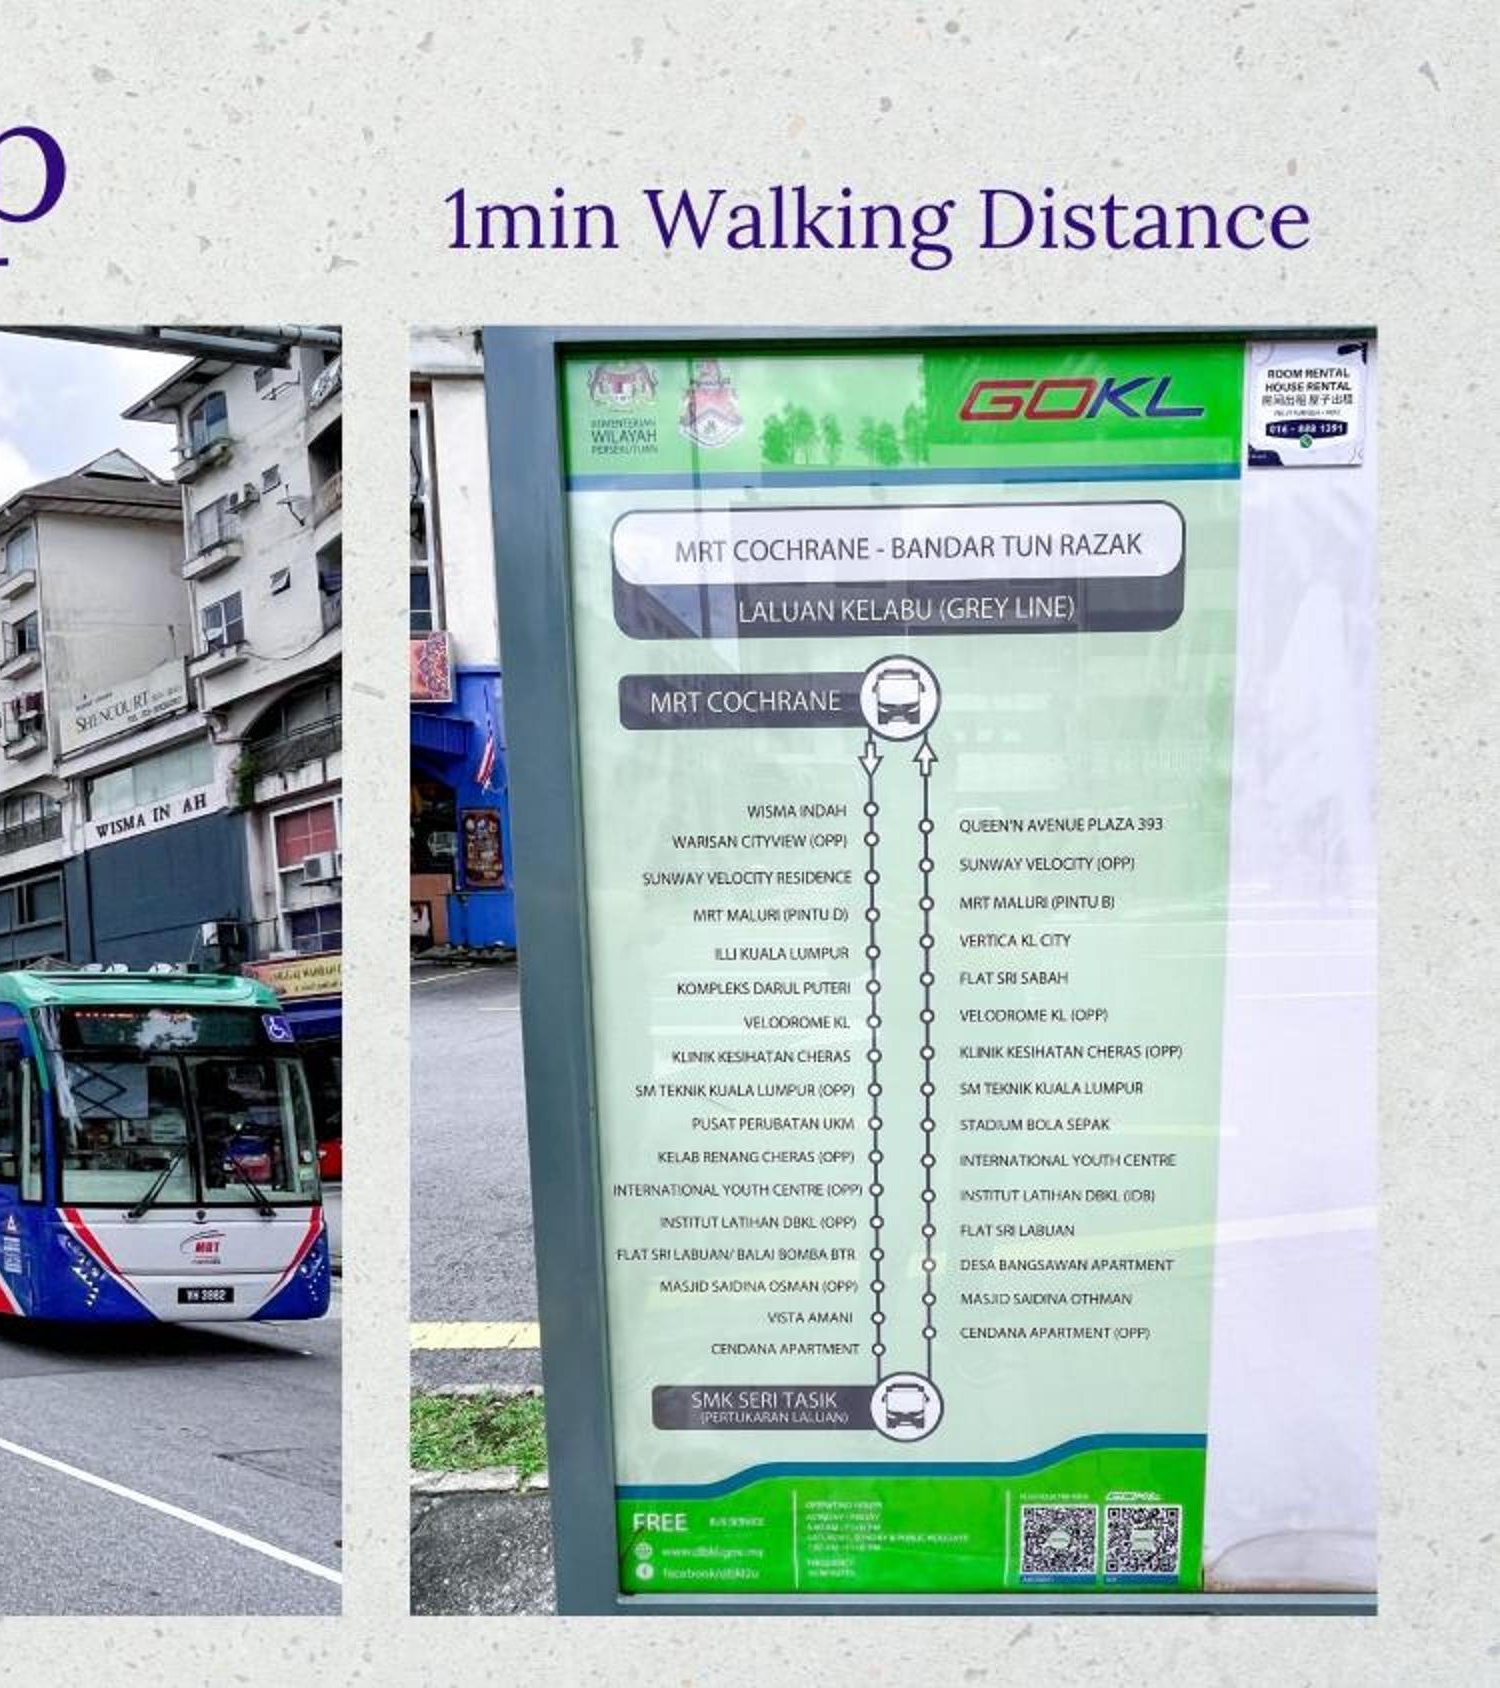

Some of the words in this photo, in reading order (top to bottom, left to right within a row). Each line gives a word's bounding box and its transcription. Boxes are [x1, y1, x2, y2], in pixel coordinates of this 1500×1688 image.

[1267, 369, 1303, 379] ROOM
[1305, 368, 1351, 378] RENTAL
[1265, 382, 1305, 392] HOUSE
[1306, 382, 1352, 391] RENTAL
[591, 430, 657, 443] WILAYAH
[675, 539, 728, 564] MRT
[732, 537, 870, 562] COCHRANE
[891, 535, 995, 560] BANDAR
[1002, 534, 1055, 557] TUN
[1060, 533, 1142, 557] RAZAK
[738, 600, 835, 624] LALUAN
[841, 597, 932, 622] KELABU
[939, 596, 1006, 624] (GREY
[1011, 595, 1076, 622] LINE)
[650, 690, 703, 715] MRT
[707, 688, 842, 714] COCHRANE
[747, 804, 798, 818] WISMA
[799, 804, 847, 818] INDAH
[95, 813, 146, 838] WISMA
[1027, 818, 1085, 832] AVENUE
[1087, 818, 1135, 831] PLAZA
[1137, 817, 1163, 831] 393
[672, 835, 737, 849] WARISAN
[741, 835, 808, 849] CITYVIEW
[809, 834, 848, 850] (OPP)
[959, 858, 1024, 871] SUNWAY
[1026, 857, 1095, 871] VELOCITY
[1097, 856, 1135, 872] (OPP)
[643, 872, 705, 886] SUNWAY
[707, 871, 773, 885] VELOCITY
[776, 870, 852, 885] RESIDENCE
[959, 896, 992, 909] MRT
[993, 896, 1050, 909] MALURI
[1051, 895, 1099, 911] (PINTU
[693, 909, 724, 923] MRT
[727, 909, 781, 922] MALURI
[783, 908, 829, 924] (PINTU
[831, 908, 849, 923] D)
[959, 934, 1017, 947] VERTICA
[1021, 934, 1038, 947] KL
[1039, 934, 1072, 947] CITY
[740, 947, 787, 960] KUALA
[789, 946, 850, 960] LUMPUR
[959, 972, 994, 985] FLAT
[996, 972, 1017, 985] SRI
[1021, 972, 1069, 985] SABAH
[677, 982, 750, 995] KOMPLEKS
[753, 982, 801, 995] DARUL
[803, 982, 851, 994] PUTERI
[743, 1016, 831, 1029] VELODROME
[833, 1016, 851, 1029] KL
[959, 1009, 1048, 1022] VELODROME
[1051, 1009, 1067, 1022] KL
[1070, 1008, 1108, 1023] (OPP)
[672, 1050, 716, 1063] KLINIK
[718, 1050, 795, 1063] KESIHATAN
[797, 1050, 851, 1063] CHERAS
[959, 1046, 1004, 1059] KLINIK
[1006, 1046, 1084, 1059] KESIHATAN
[1087, 1045, 1142, 1058] CHERAS
[1144, 1045, 1183, 1059] (OPP)
[635, 1085, 657, 1098] SM
[659, 1084, 706, 1097] TEKNIK
[709, 1084, 755, 1097] KUALA
[756, 1084, 816, 1097] LUMPUR
[818, 1083, 855, 1098] (OPP)
[959, 1083, 981, 1095] SM
[984, 1083, 1032, 1095] TEKNIK
[1035, 1082, 1081, 1095] KUALA
[1084, 1082, 1144, 1095] LUMPUR
[692, 1118, 737, 1131] PUSAT
[739, 1118, 821, 1130] PERUBATAN
[823, 1118, 855, 1130] UKM
[960, 1119, 1023, 1131] STADIUM
[1026, 1119, 1064, 1131] BOLA
[1066, 1119, 1110, 1130] SEPAK
[657, 1151, 700, 1164] KELAB
[703, 1151, 760, 1164] RENANG
[761, 1151, 815, 1164] CHERAS
[818, 1151, 855, 1165] (OPP)
[959, 1155, 1069, 1167] INTERNATIONAL
[1072, 1155, 1121, 1166] YOUTH
[1123, 1154, 1177, 1166] CENTRE
[613, 1184, 720, 1197] INTERNATIONAL
[722, 1184, 770, 1197] YOUTH
[771, 1184, 827, 1197] CENTRE
[827, 1184, 864, 1198] (OPP)
[960, 1190, 1021, 1202] INSTITUT
[1023, 1190, 1081, 1202] LATIHAN
[1085, 1190, 1120, 1202] DBKL
[660, 1216, 720, 1229] INSTITUT
[721, 1216, 780, 1229] LATIHAN
[782, 1216, 818, 1229] DBKL
[820, 1216, 857, 1230] (OPP)
[960, 1225, 993, 1236] FLAT
[995, 1225, 1016, 1236] SRI
[1018, 1225, 1075, 1236] LABUAN
[195, 1241, 220, 1253] MRT
[616, 1249, 649, 1261] FLAT
[651, 1249, 671, 1261] SRI
[737, 1248, 776, 1261] BALAI
[778, 1248, 828, 1261] BOMBA
[830, 1248, 856, 1261] BTR
[960, 1259, 996, 1271] DESA
[999, 1259, 1088, 1271] BANGSAWAN
[1090, 1259, 1175, 1271] APARTMENT
[659, 1281, 709, 1293] MASJID
[711, 1280, 767, 1293] SAIDINA
[768, 1280, 820, 1293] OSMAN
[821, 1280, 859, 1294] (OPP)
[960, 1293, 1011, 1305] MASJID
[1013, 1293, 1066, 1305] SAIDINA
[1070, 1293, 1133, 1305] OTHMAN
[768, 1311, 805, 1324] VISTA
[807, 1311, 853, 1324] AMANI
[960, 1327, 1027, 1339] CENDANA
[1029, 1327, 1110, 1339] APARTMENT
[1113, 1326, 1151, 1340] (OPP)
[711, 1343, 778, 1355] CENDANA
[779, 1343, 861, 1355] APARTMENT
[692, 1391, 733, 1409] SMK
[739, 1391, 779, 1408] SERI
[784, 1391, 838, 1408] TASIK
[700, 1411, 788, 1425] (PERTUKARAN
[792, 1411, 849, 1424] LALUAN)
[633, 1512, 688, 1533] FREE
